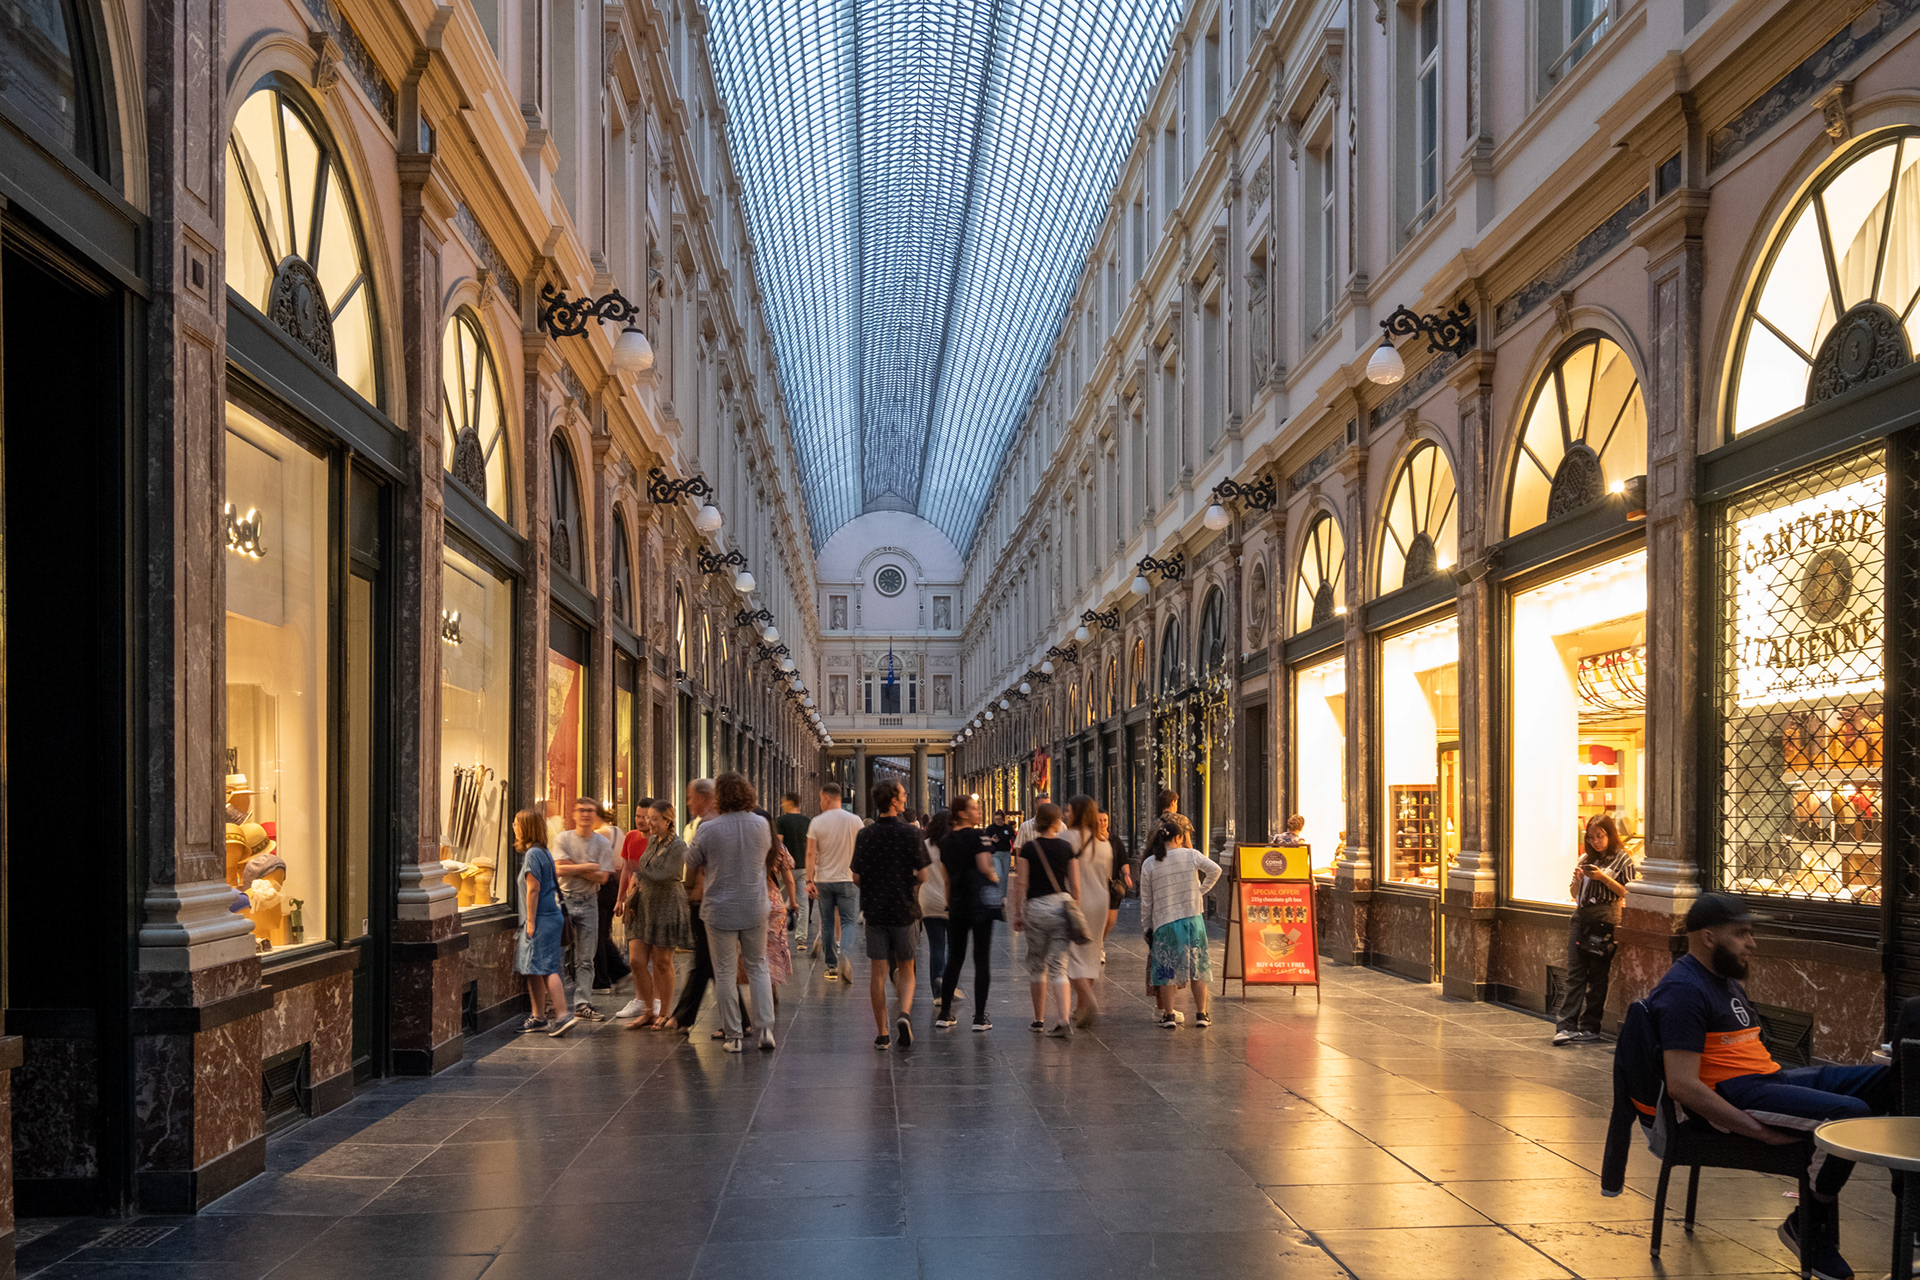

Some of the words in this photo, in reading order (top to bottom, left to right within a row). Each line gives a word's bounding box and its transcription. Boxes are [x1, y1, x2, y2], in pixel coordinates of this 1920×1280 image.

[1744, 509, 1876, 574] GANTERIE
[1741, 606, 1877, 669] ITALIENNE
[1252, 888, 1277, 896] SPECIAL
[1278, 888, 1300, 896] OFFER!
